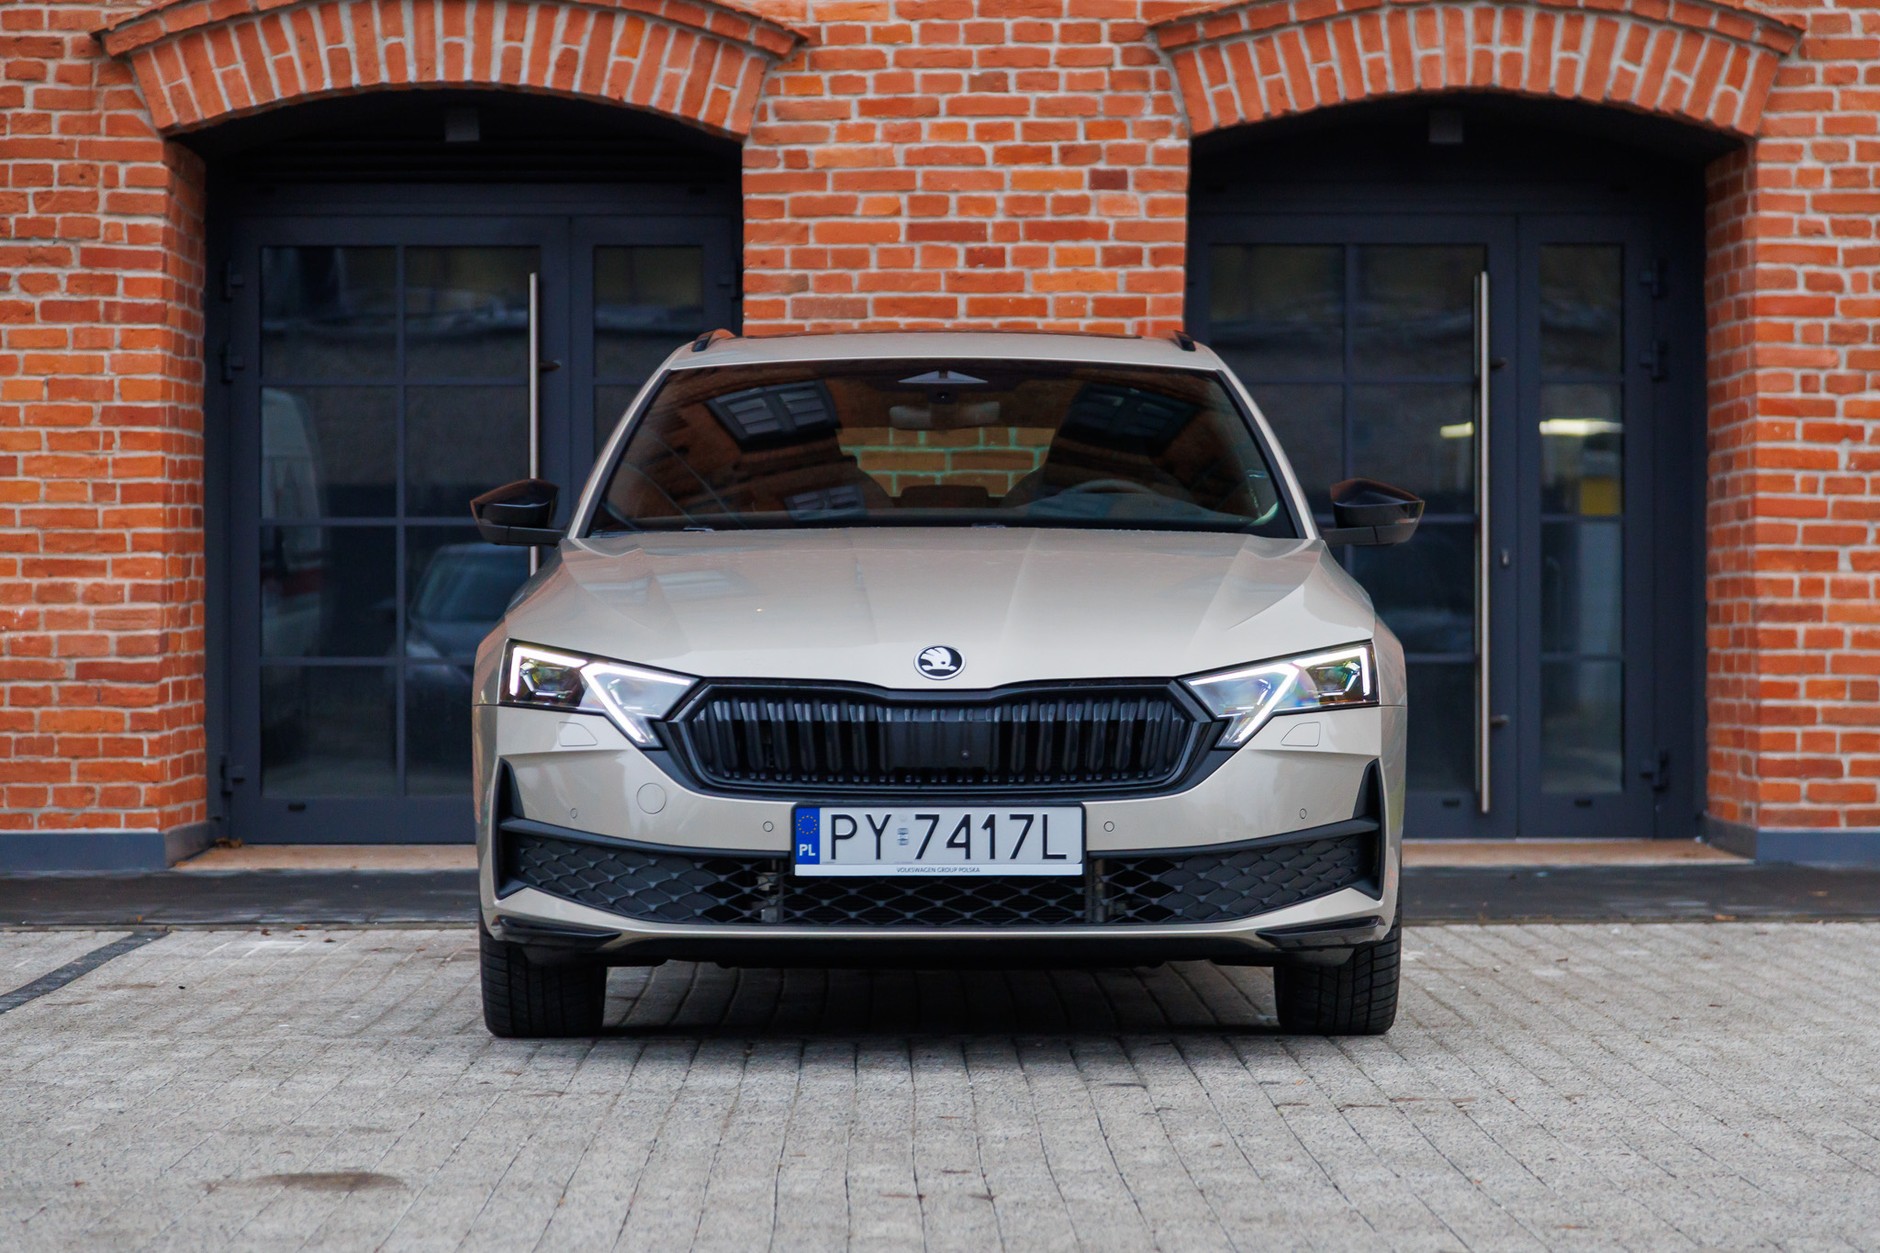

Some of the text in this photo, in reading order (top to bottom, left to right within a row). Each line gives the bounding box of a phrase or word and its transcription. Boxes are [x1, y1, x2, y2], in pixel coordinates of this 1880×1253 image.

[799, 843, 816, 857] PL
[830, 813, 1067, 860] PY 7417L
